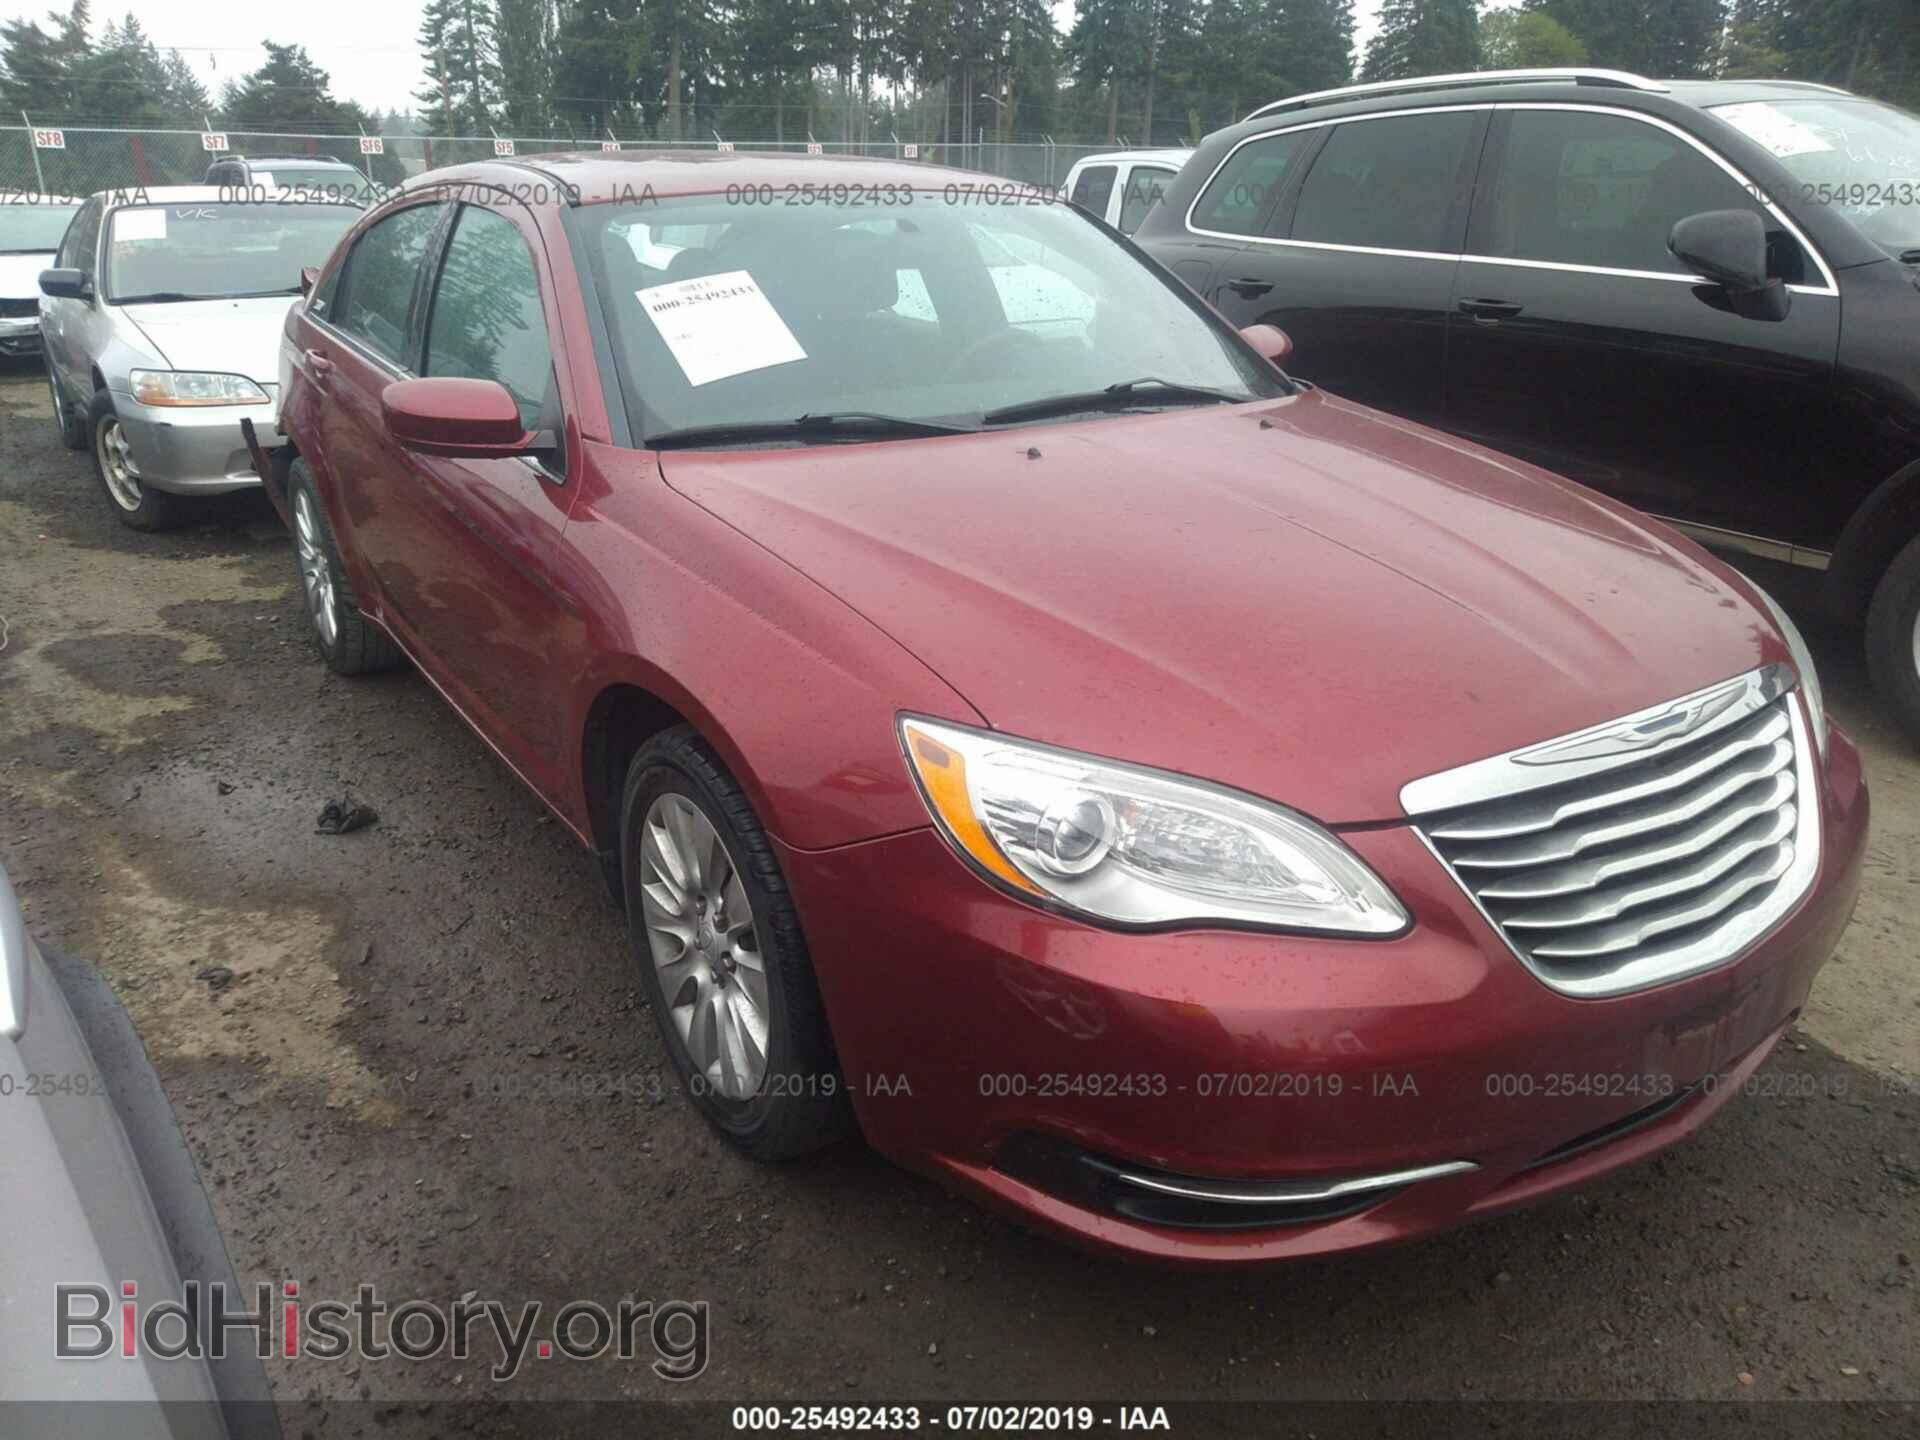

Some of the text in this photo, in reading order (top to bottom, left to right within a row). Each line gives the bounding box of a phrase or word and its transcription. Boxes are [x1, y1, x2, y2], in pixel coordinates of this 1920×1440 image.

[36, 131, 63, 147] SF8
[205, 135, 225, 149] SF7
[362, 139, 382, 153] SF6
[495, 140, 514, 154] SF5
